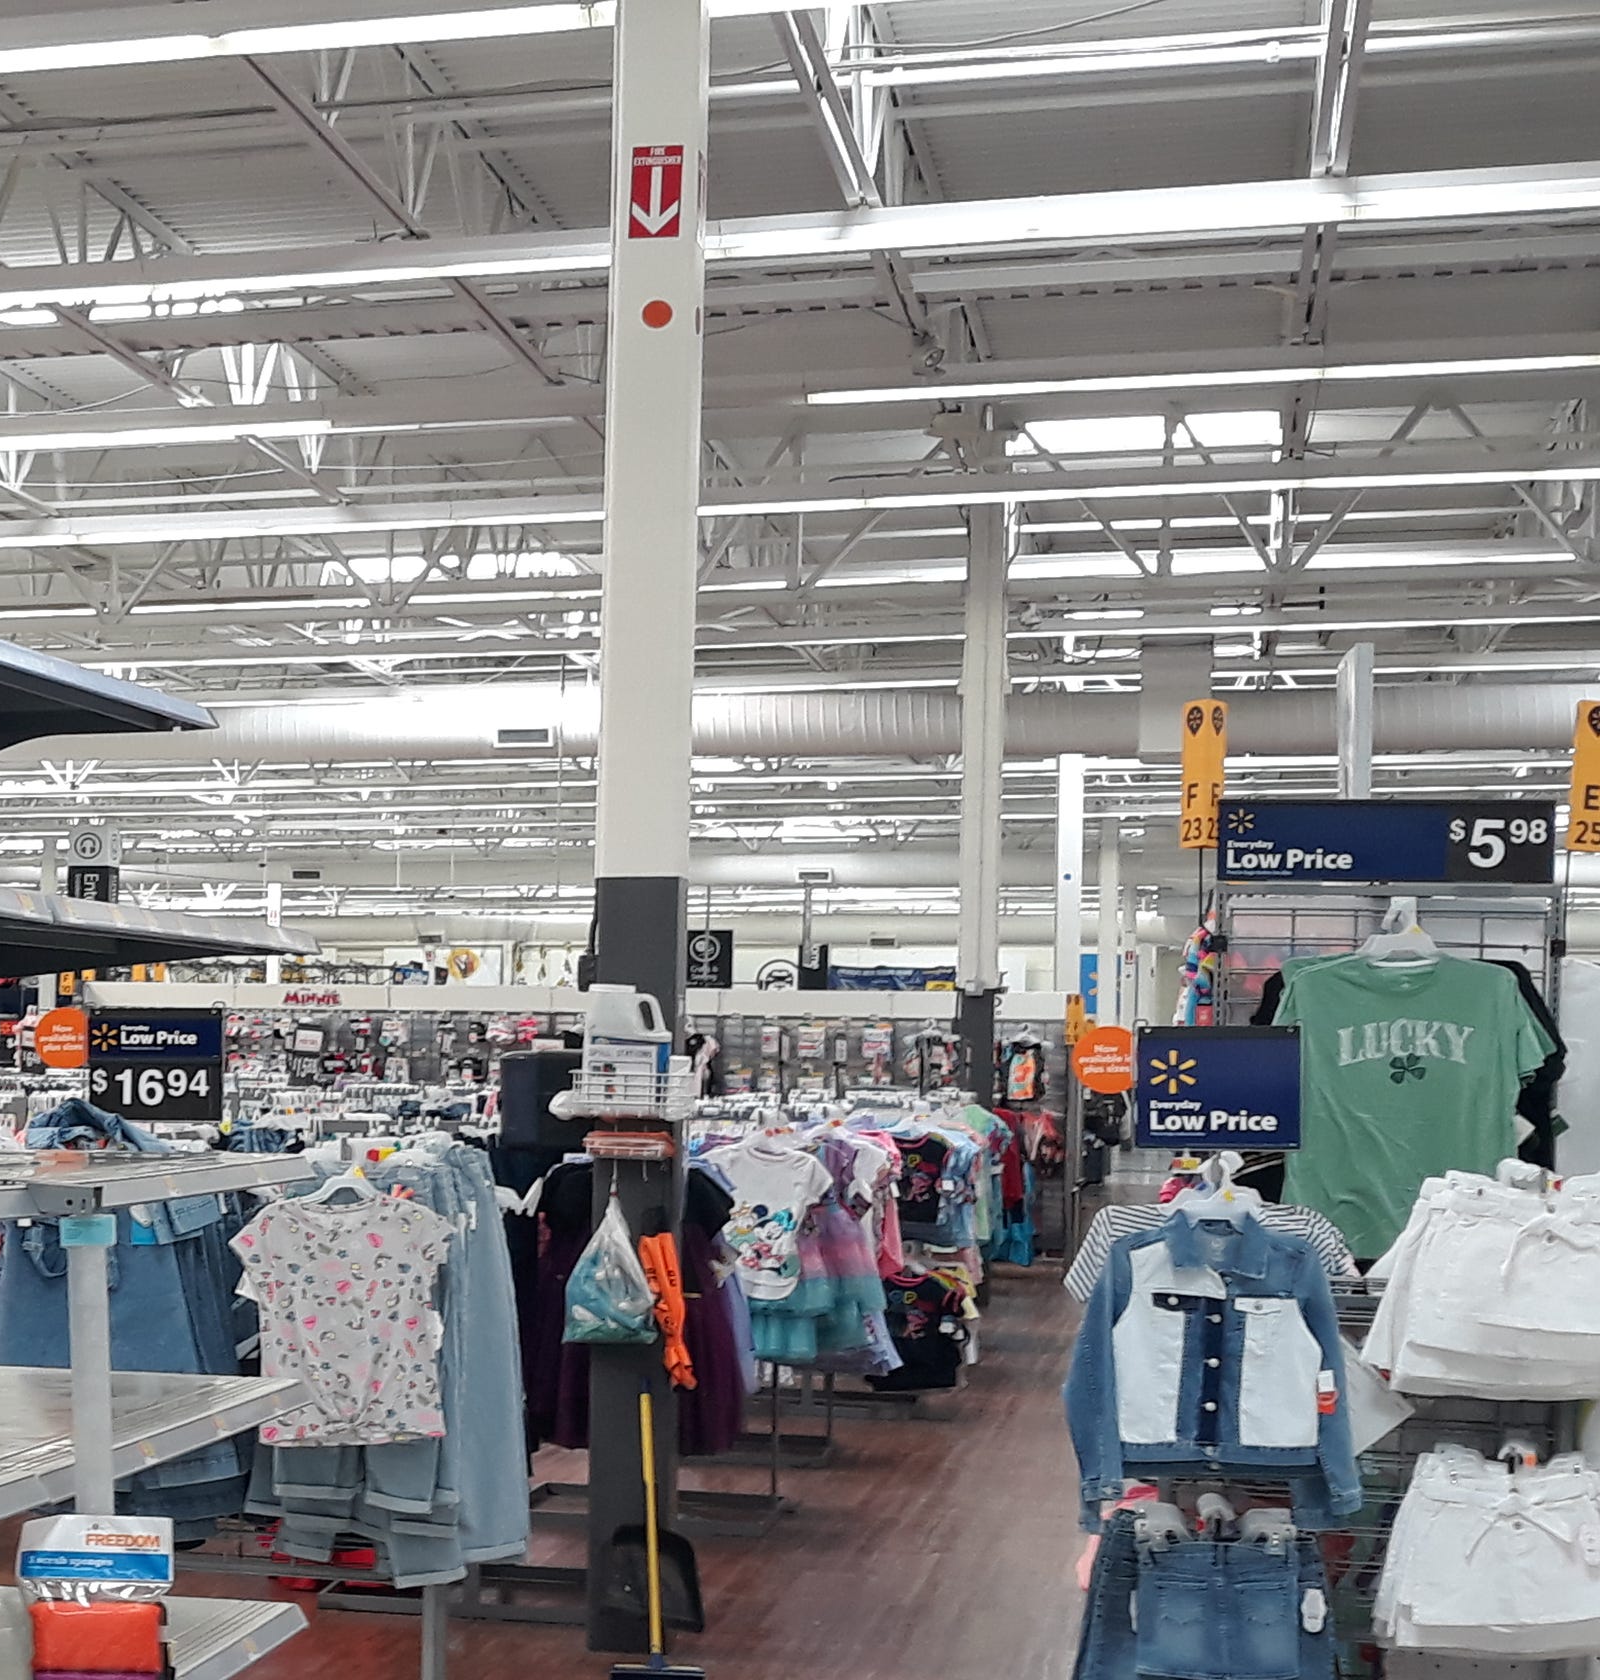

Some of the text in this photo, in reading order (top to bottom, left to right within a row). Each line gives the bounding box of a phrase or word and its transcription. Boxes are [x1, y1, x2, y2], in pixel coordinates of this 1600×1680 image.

[1187, 782, 1199, 809] F
[1583, 784, 1600, 811] E
[1181, 816, 1203, 843] 23
[1206, 816, 1219, 841] 2
[1574, 820, 1600, 845] 25
[1226, 839, 1274, 850] Everyday
[1226, 848, 1354, 870] Low Price
[120, 1030, 198, 1046] Low Price
[1337, 1017, 1475, 1067] LUCKY
[1078, 1054, 1124, 1064] available
[1082, 1064, 1105, 1075] plus
[1149, 1100, 1202, 1112] Everyday
[1149, 1110, 1278, 1131] Low Price
[85, 1533, 161, 1548] FREEDOM
[35, 1556, 68, 1565] scrub
[69, 1558, 114, 1568] sponges
